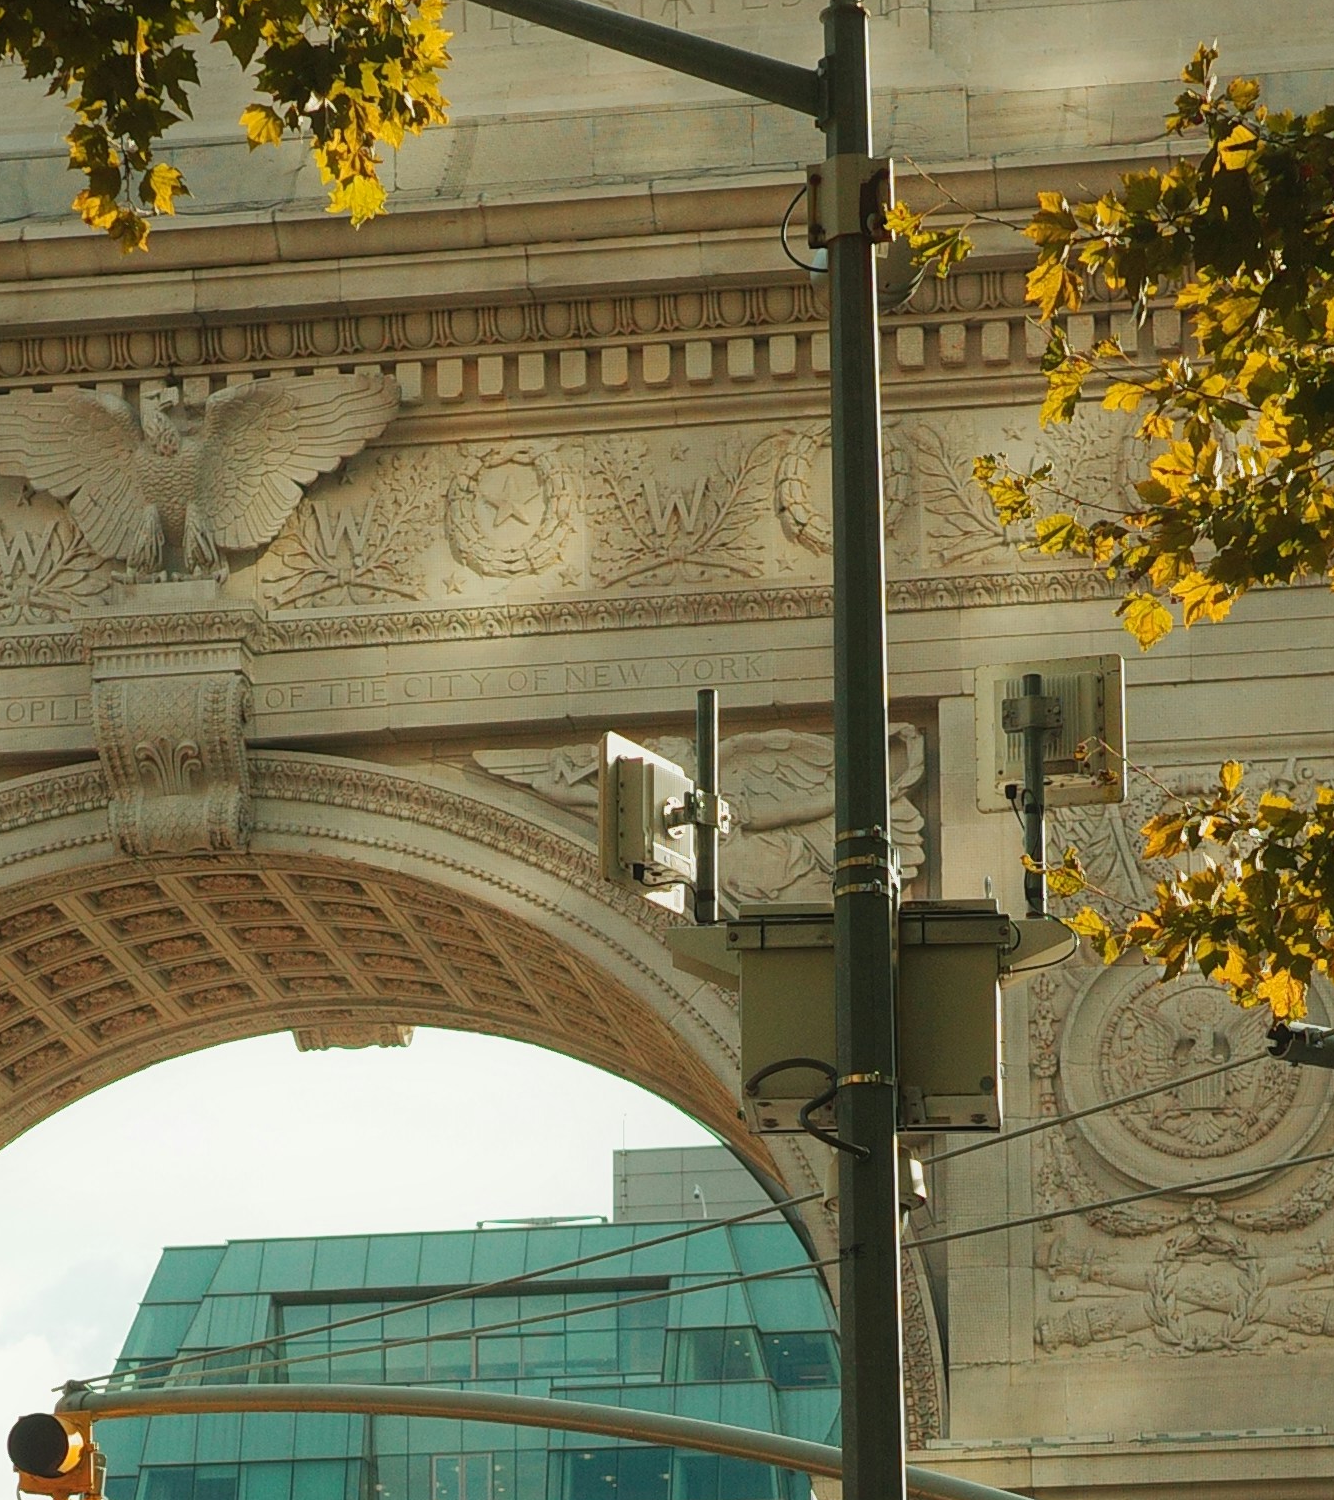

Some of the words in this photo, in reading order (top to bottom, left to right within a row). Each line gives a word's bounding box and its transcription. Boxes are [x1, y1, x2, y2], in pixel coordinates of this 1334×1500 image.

[266, 685, 304, 709] OF
[321, 681, 386, 706] THE
[403, 673, 492, 698] CITY
[508, 668, 550, 692] OF
[566, 663, 647, 688] NEW
[668, 654, 763, 681] YORK
